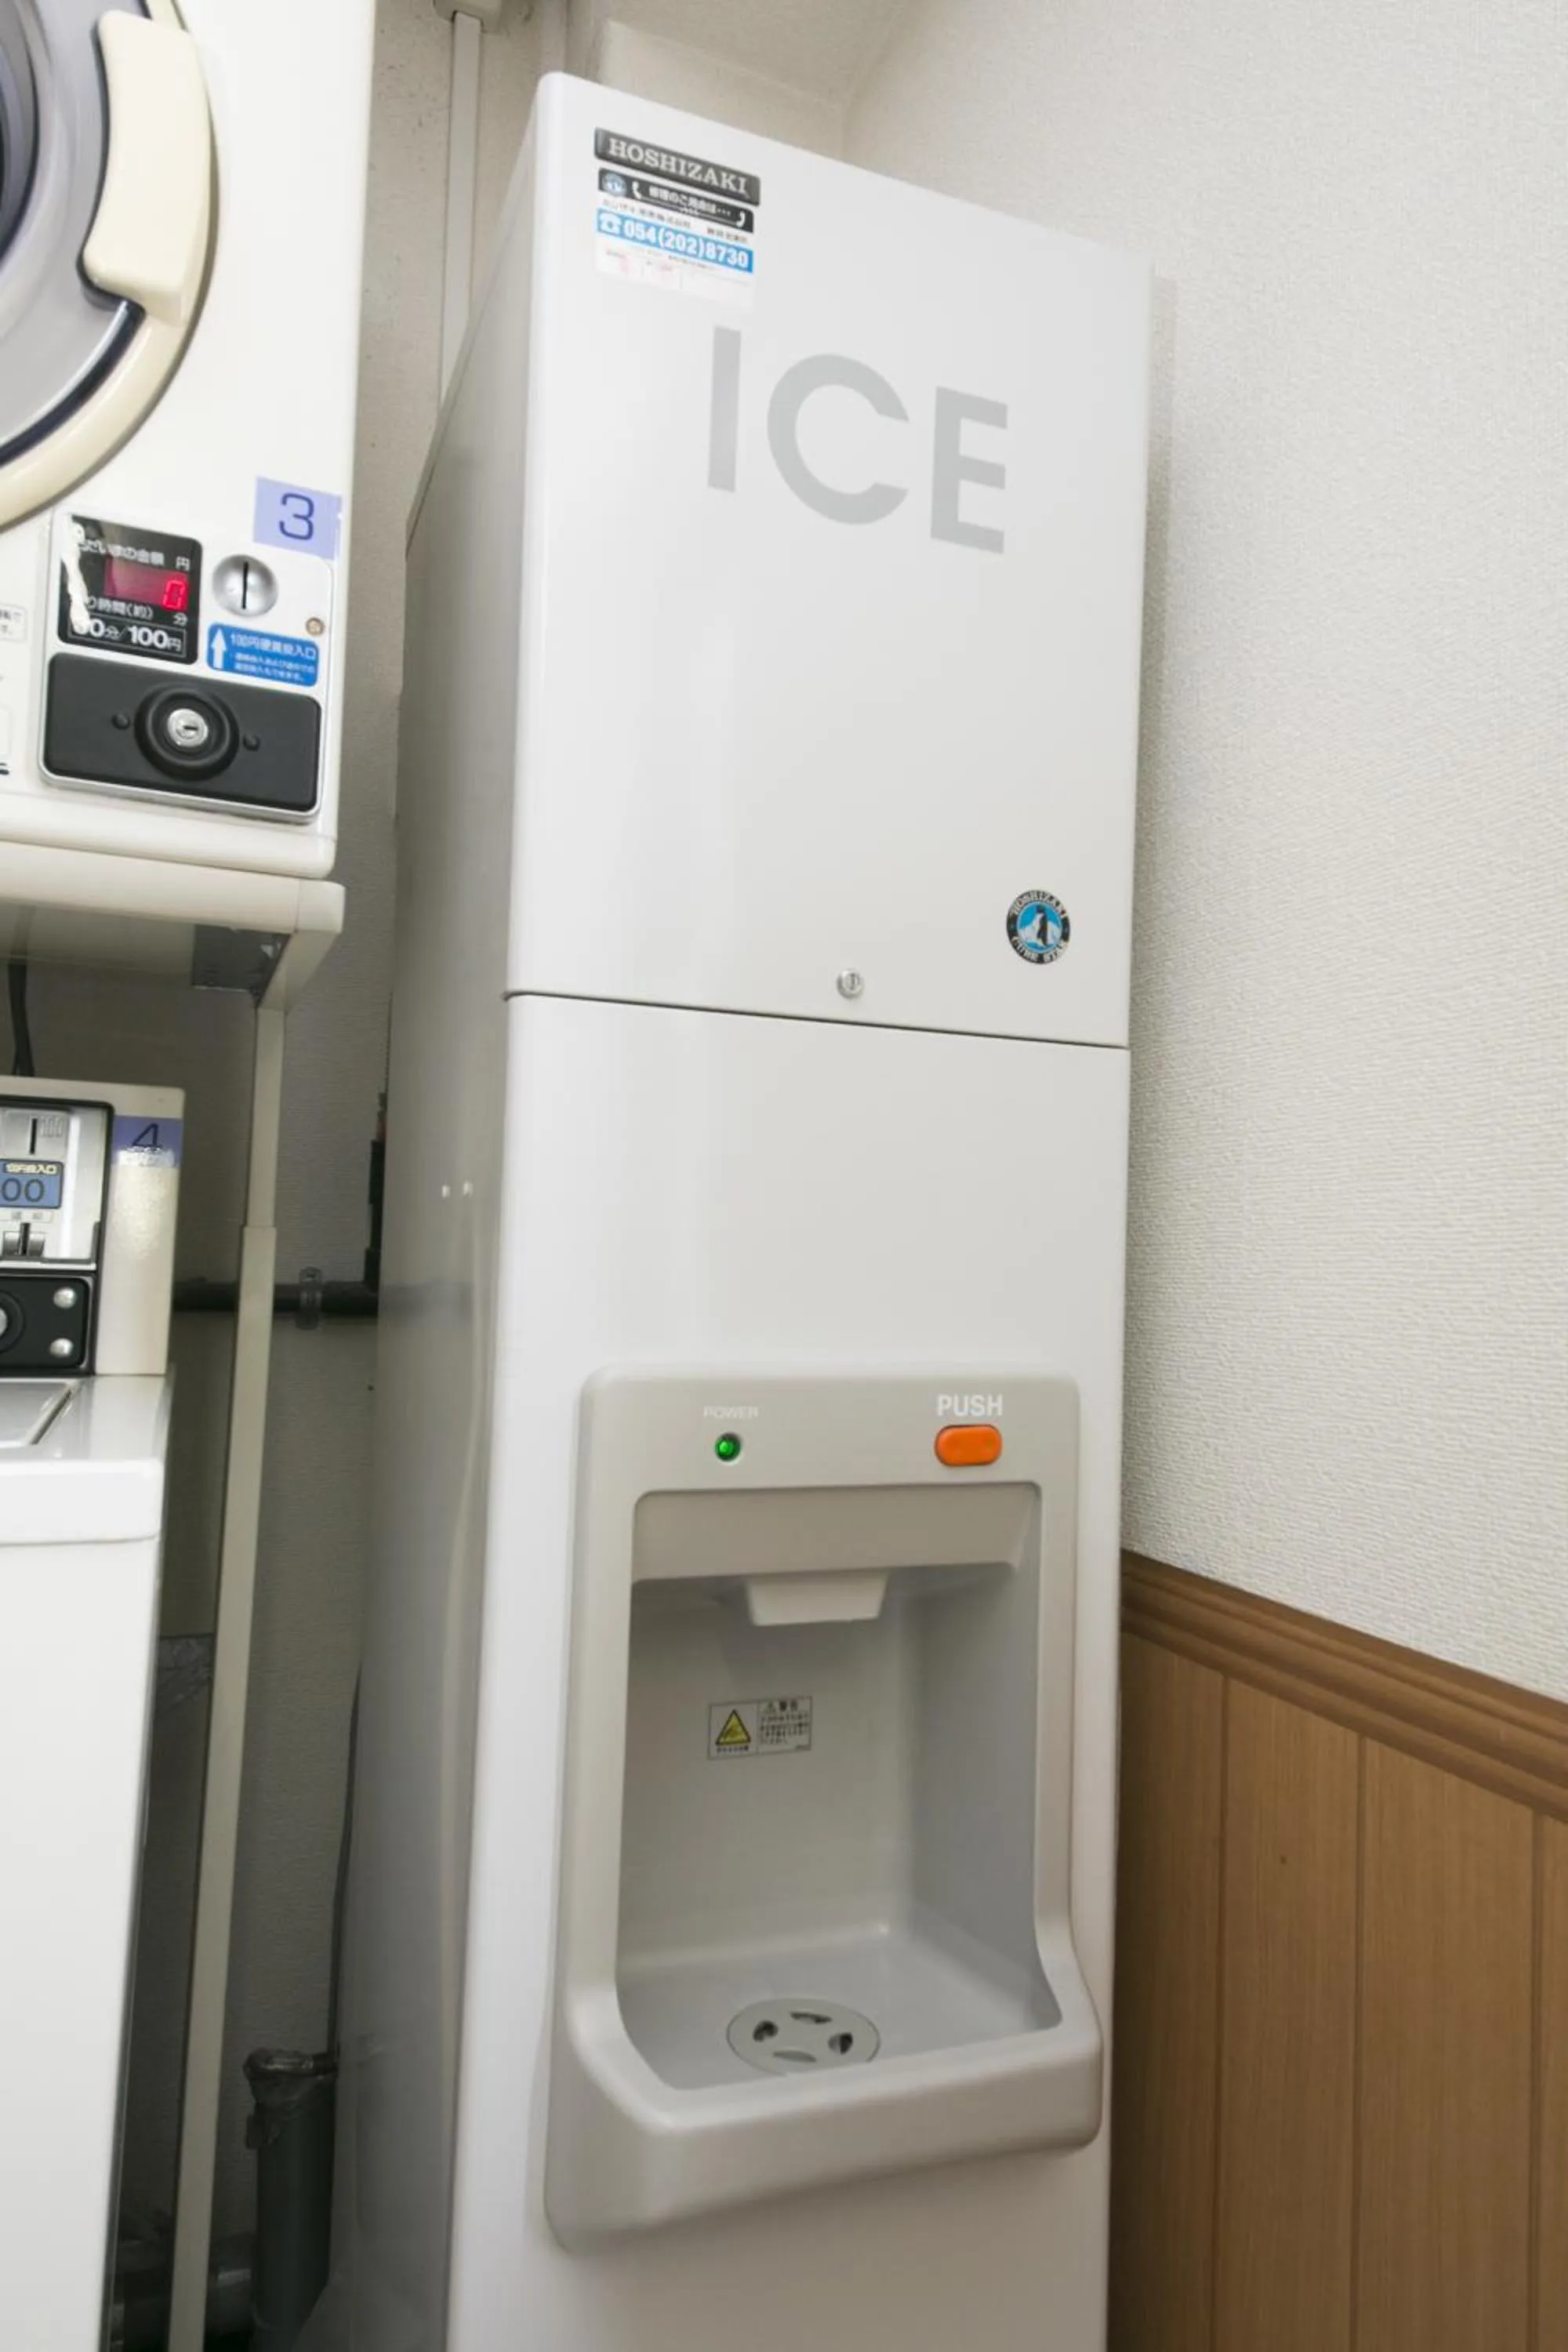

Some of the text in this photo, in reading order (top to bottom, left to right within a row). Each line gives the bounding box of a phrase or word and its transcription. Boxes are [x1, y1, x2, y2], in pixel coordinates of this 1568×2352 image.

[608, 137, 750, 195] HOSHIZAKI
[623, 220, 748, 268] 054(202)8730
[707, 325, 1008, 554] ICE
[278, 492, 314, 541] 3
[176, 556, 191, 572] 円
[163, 579, 186, 608] 0
[172, 612, 188, 626] 分
[78, 617, 182, 652] 0分/100円
[131, 1122, 163, 1151] 4
[703, 1406, 758, 1418] POWER
[936, 1393, 1004, 1417] PUSH
